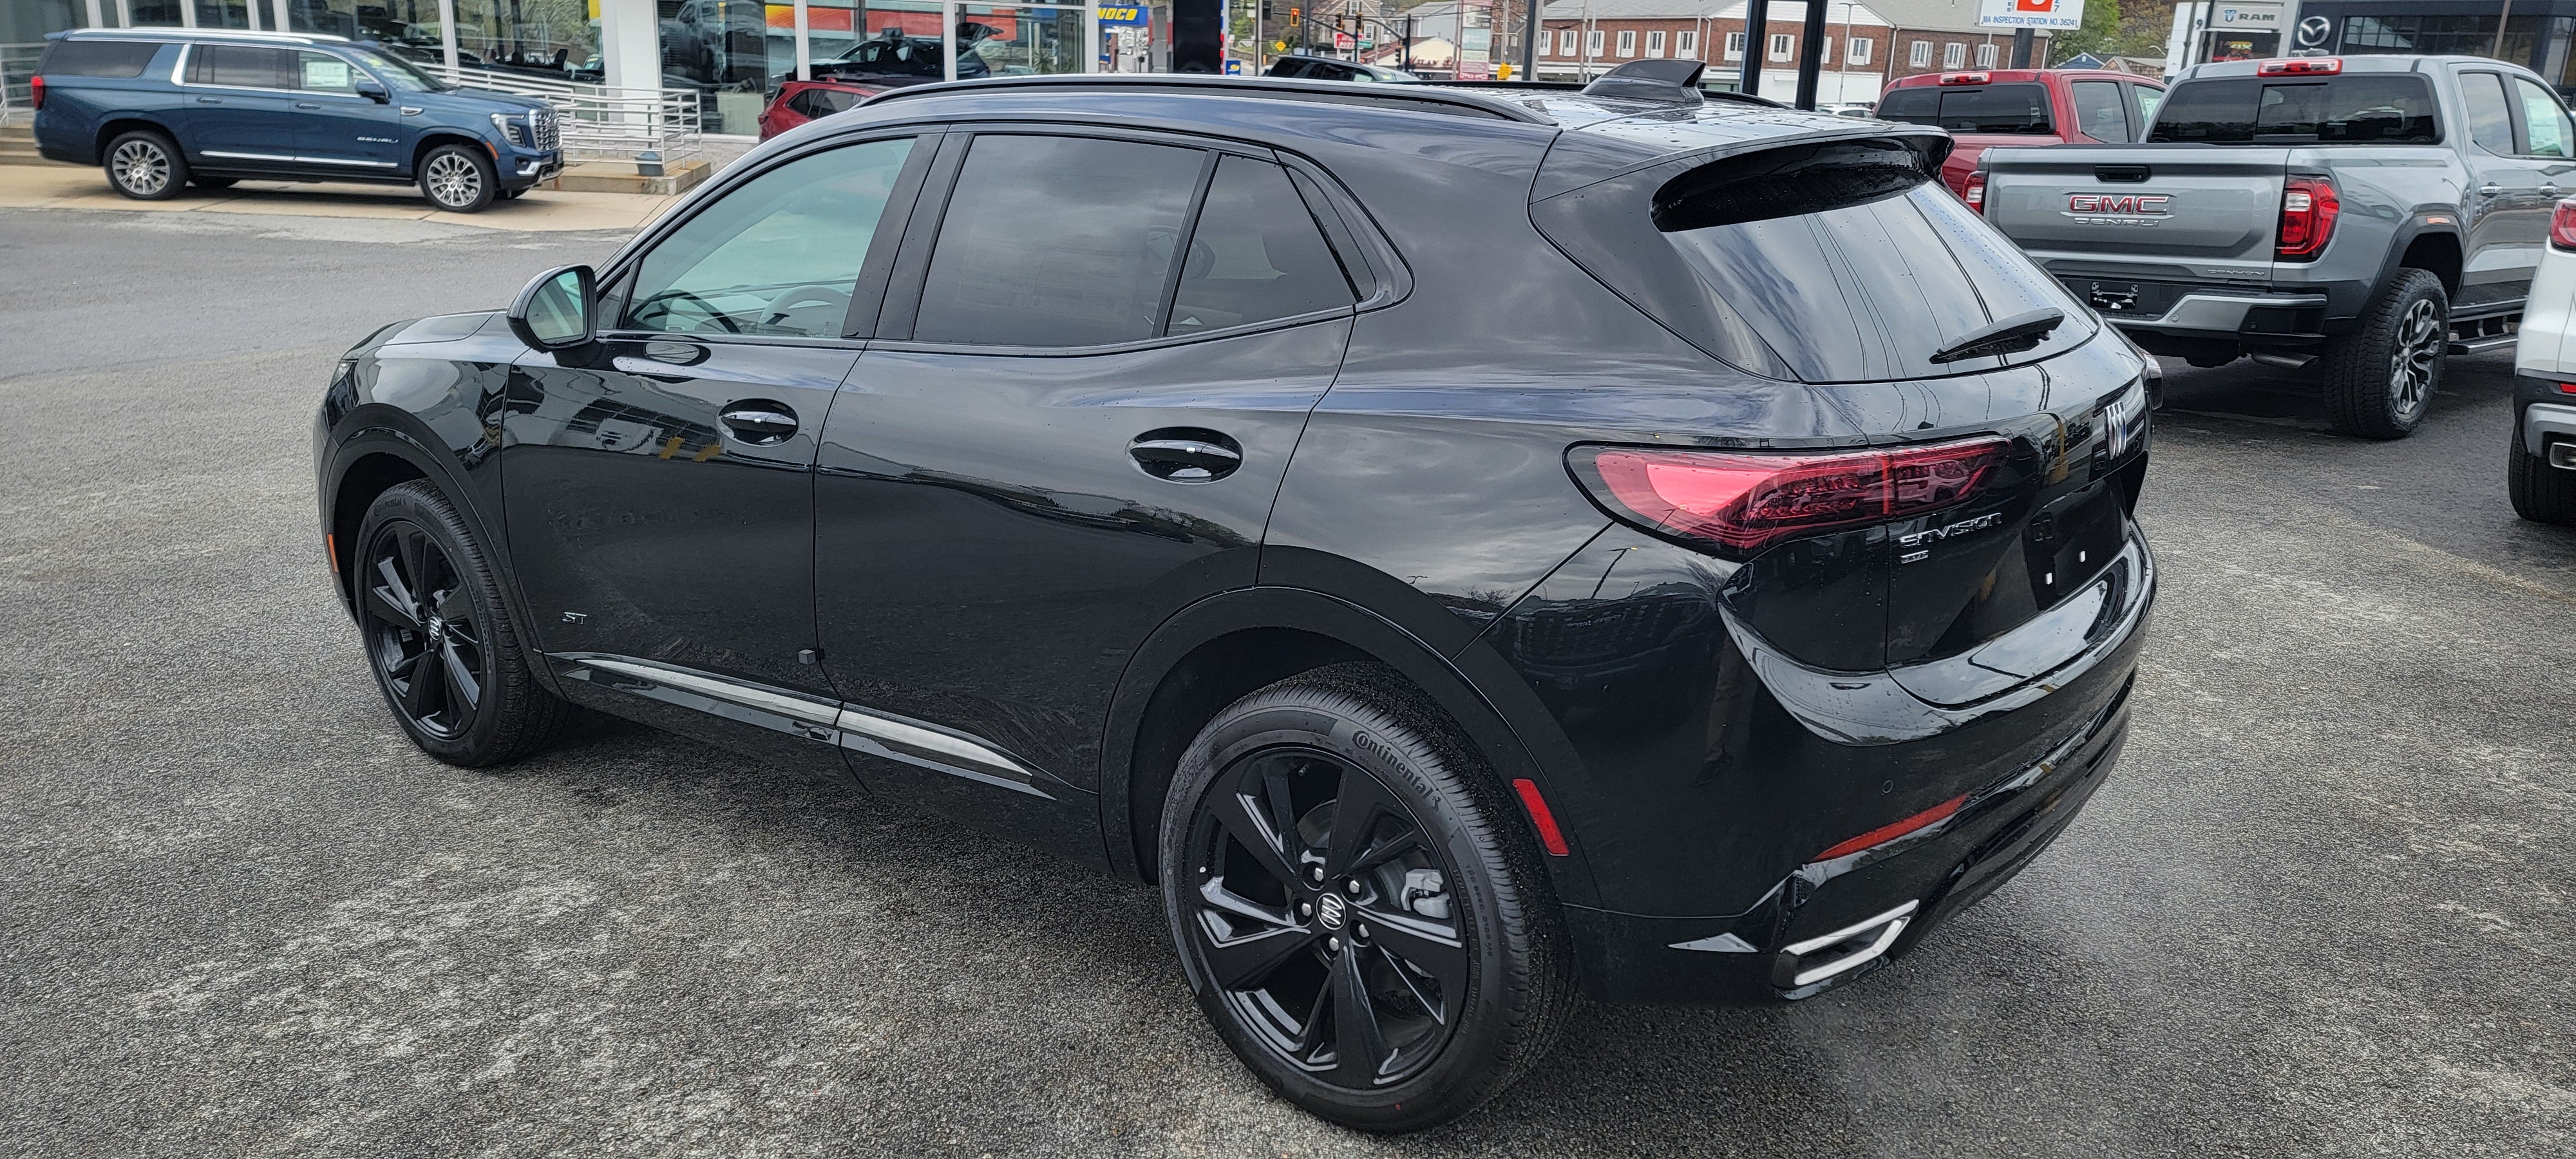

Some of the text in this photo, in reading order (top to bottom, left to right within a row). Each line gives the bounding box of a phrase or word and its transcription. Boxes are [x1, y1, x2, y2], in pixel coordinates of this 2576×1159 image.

[1097, 8, 1138, 21] NOCO
[2196, 19, 2203, 30] 9
[2069, 194, 2169, 214] GMC
[2074, 217, 2159, 227] DENALI
[1900, 513, 2002, 548] ENVISION
[562, 612, 587, 625] ST
[1352, 730, 1435, 800] Continental
